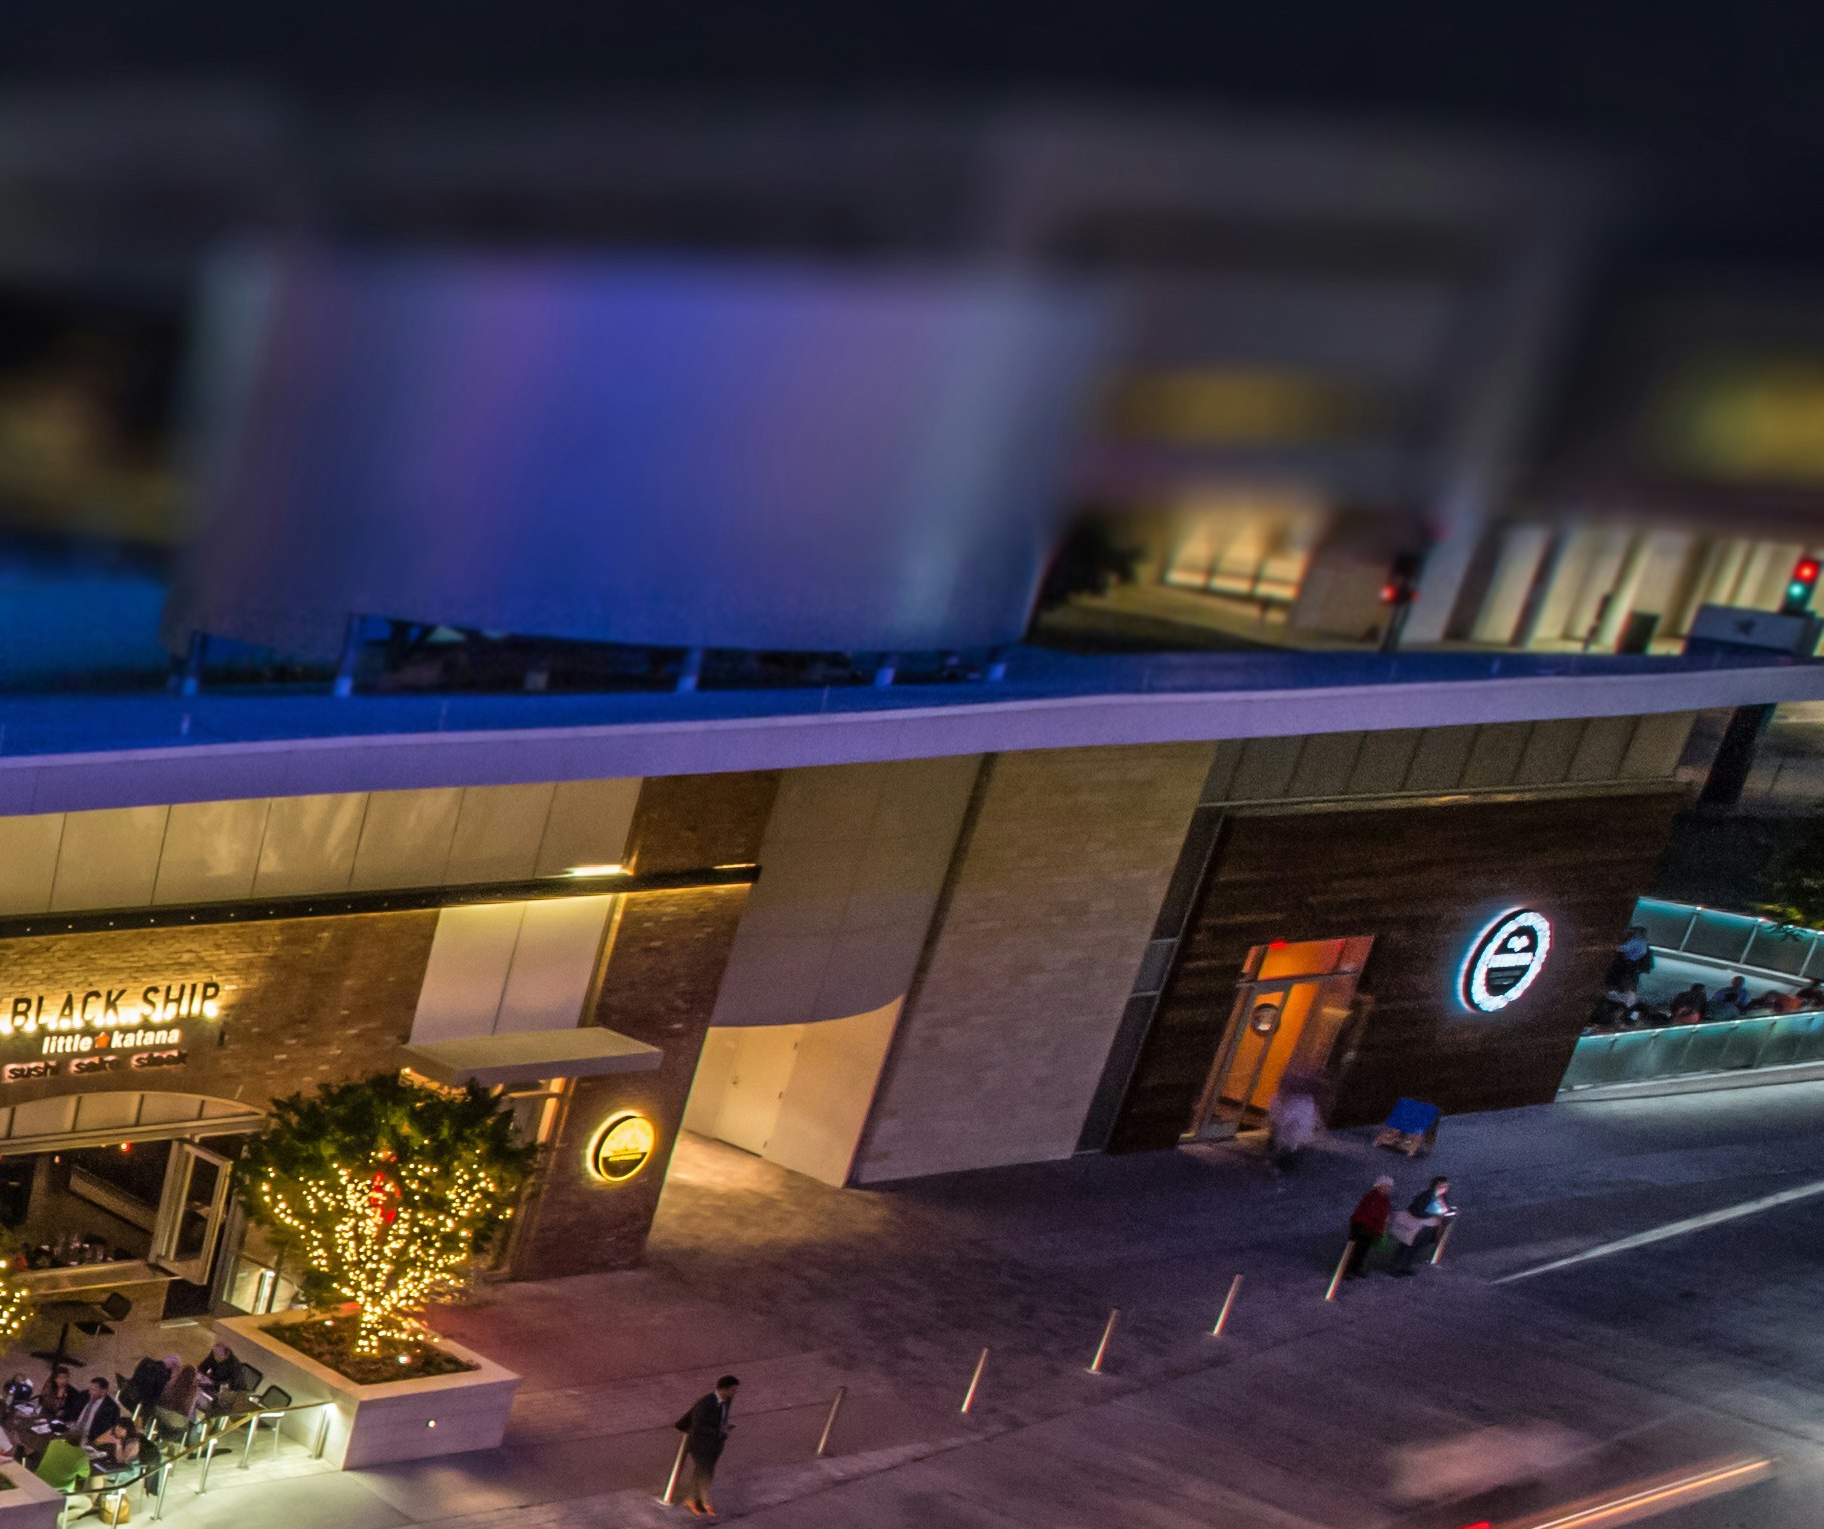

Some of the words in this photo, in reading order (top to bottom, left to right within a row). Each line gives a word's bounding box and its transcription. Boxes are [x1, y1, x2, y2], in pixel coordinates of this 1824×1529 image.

[10, 988, 127, 1026] BLACK
[142, 982, 220, 1020] SHIP
[42, 1033, 93, 1055] little
[110, 1028, 182, 1049] katana
